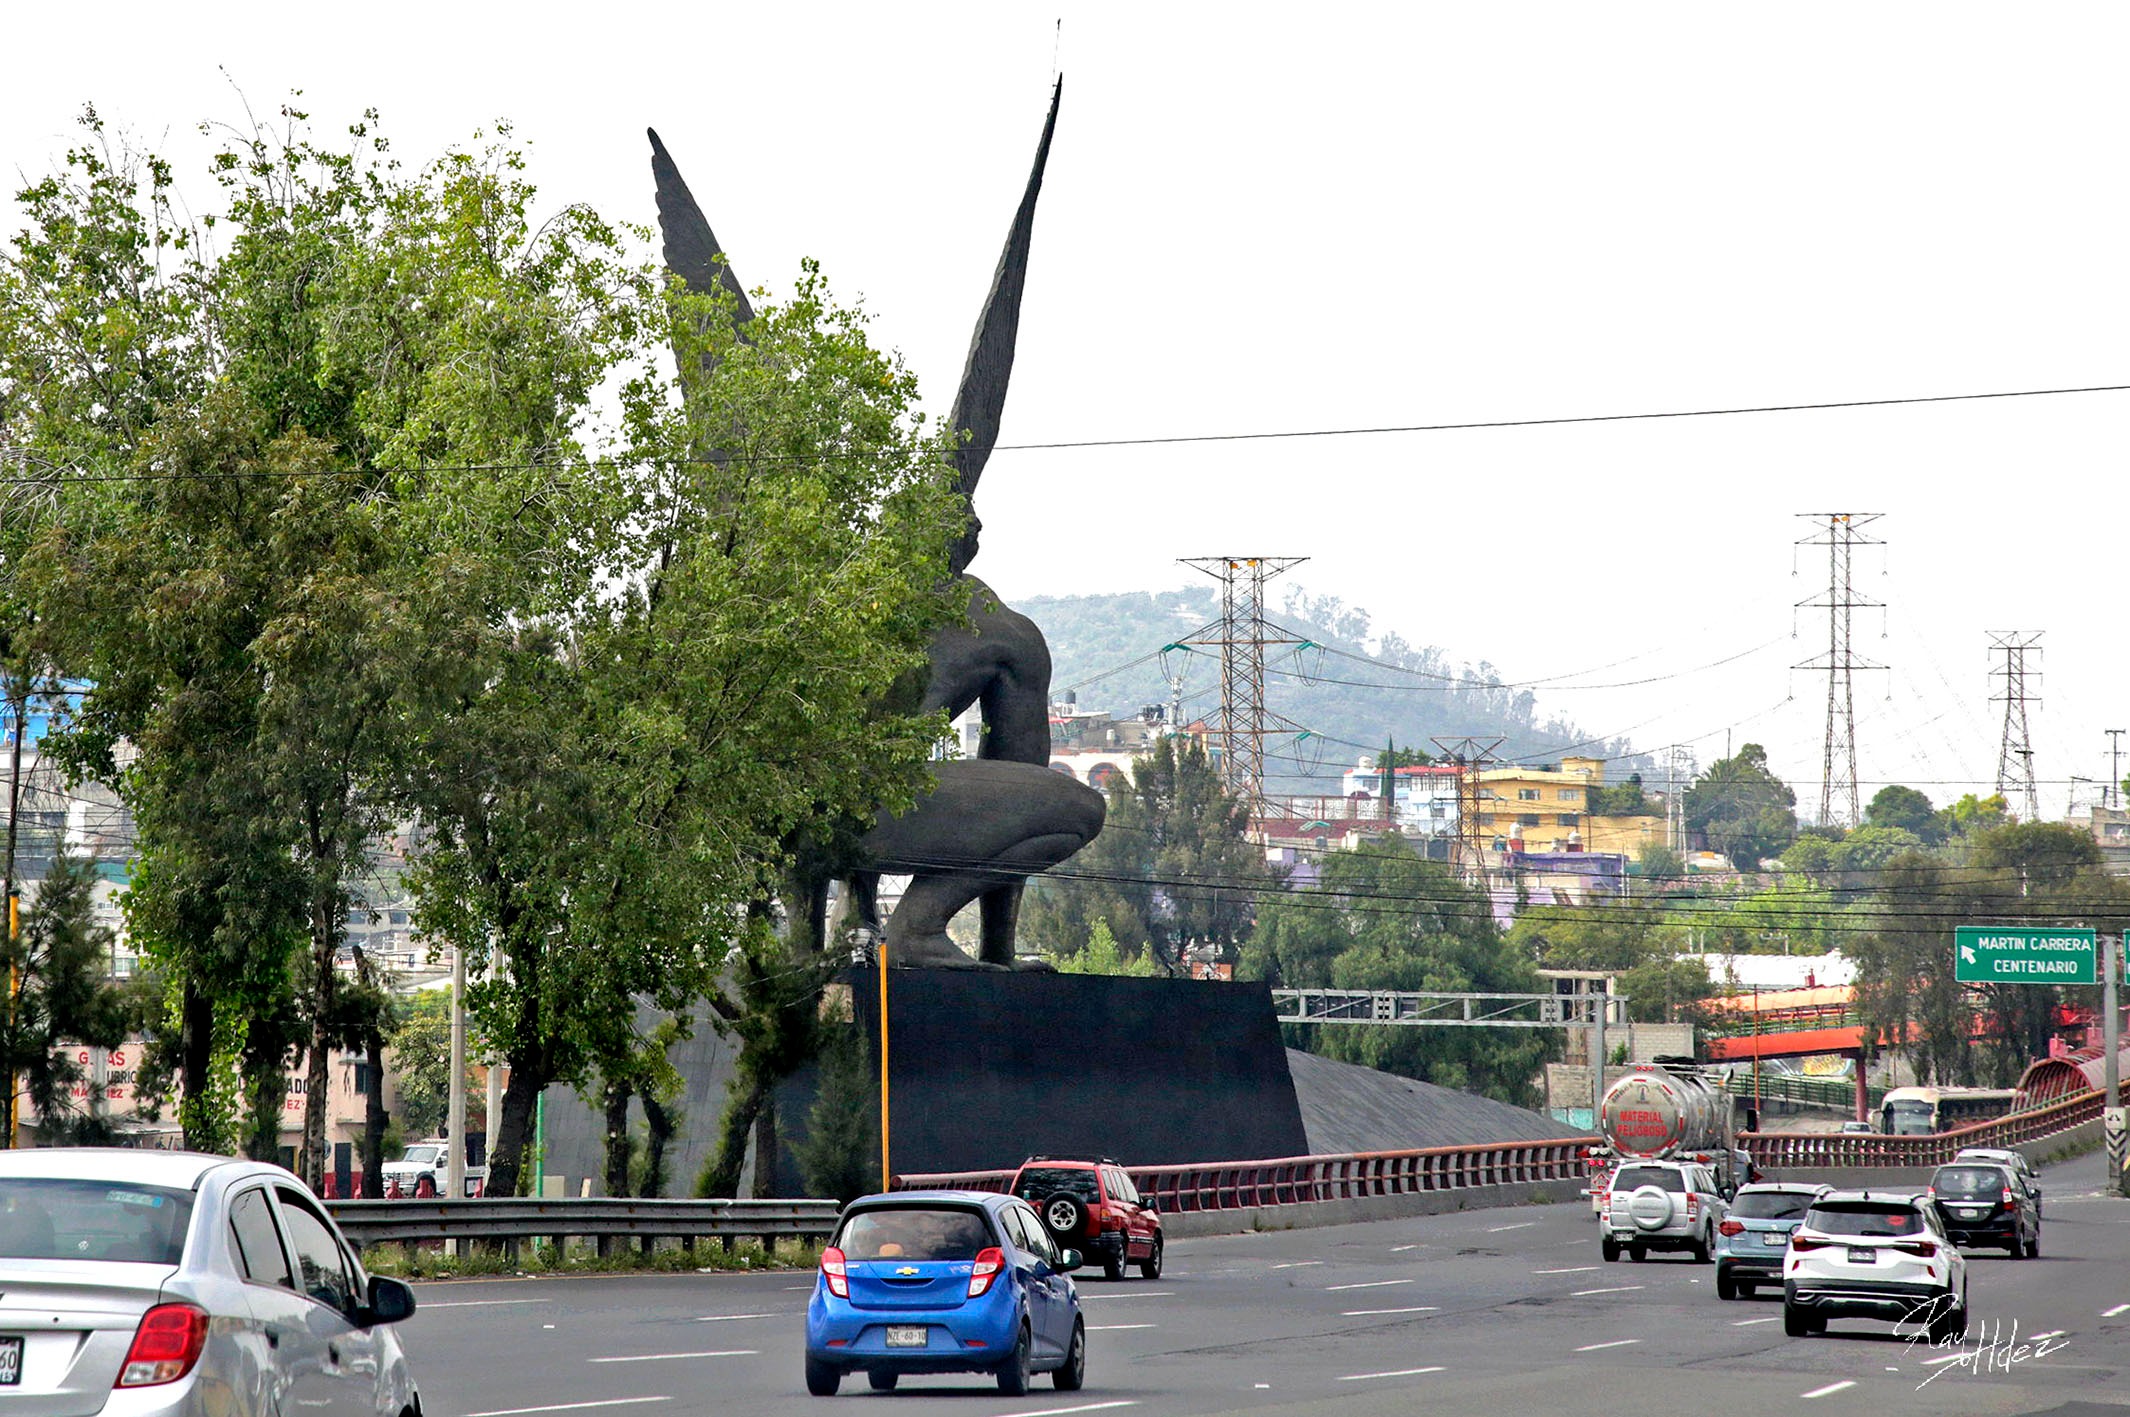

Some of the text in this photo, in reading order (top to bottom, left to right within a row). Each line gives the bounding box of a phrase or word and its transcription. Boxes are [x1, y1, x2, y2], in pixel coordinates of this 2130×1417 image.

[1978, 936, 2092, 951] MARTIN CARRERA
[1993, 959, 2078, 974] CENTENARIO
[1619, 1110, 1664, 1123] MATERIAL
